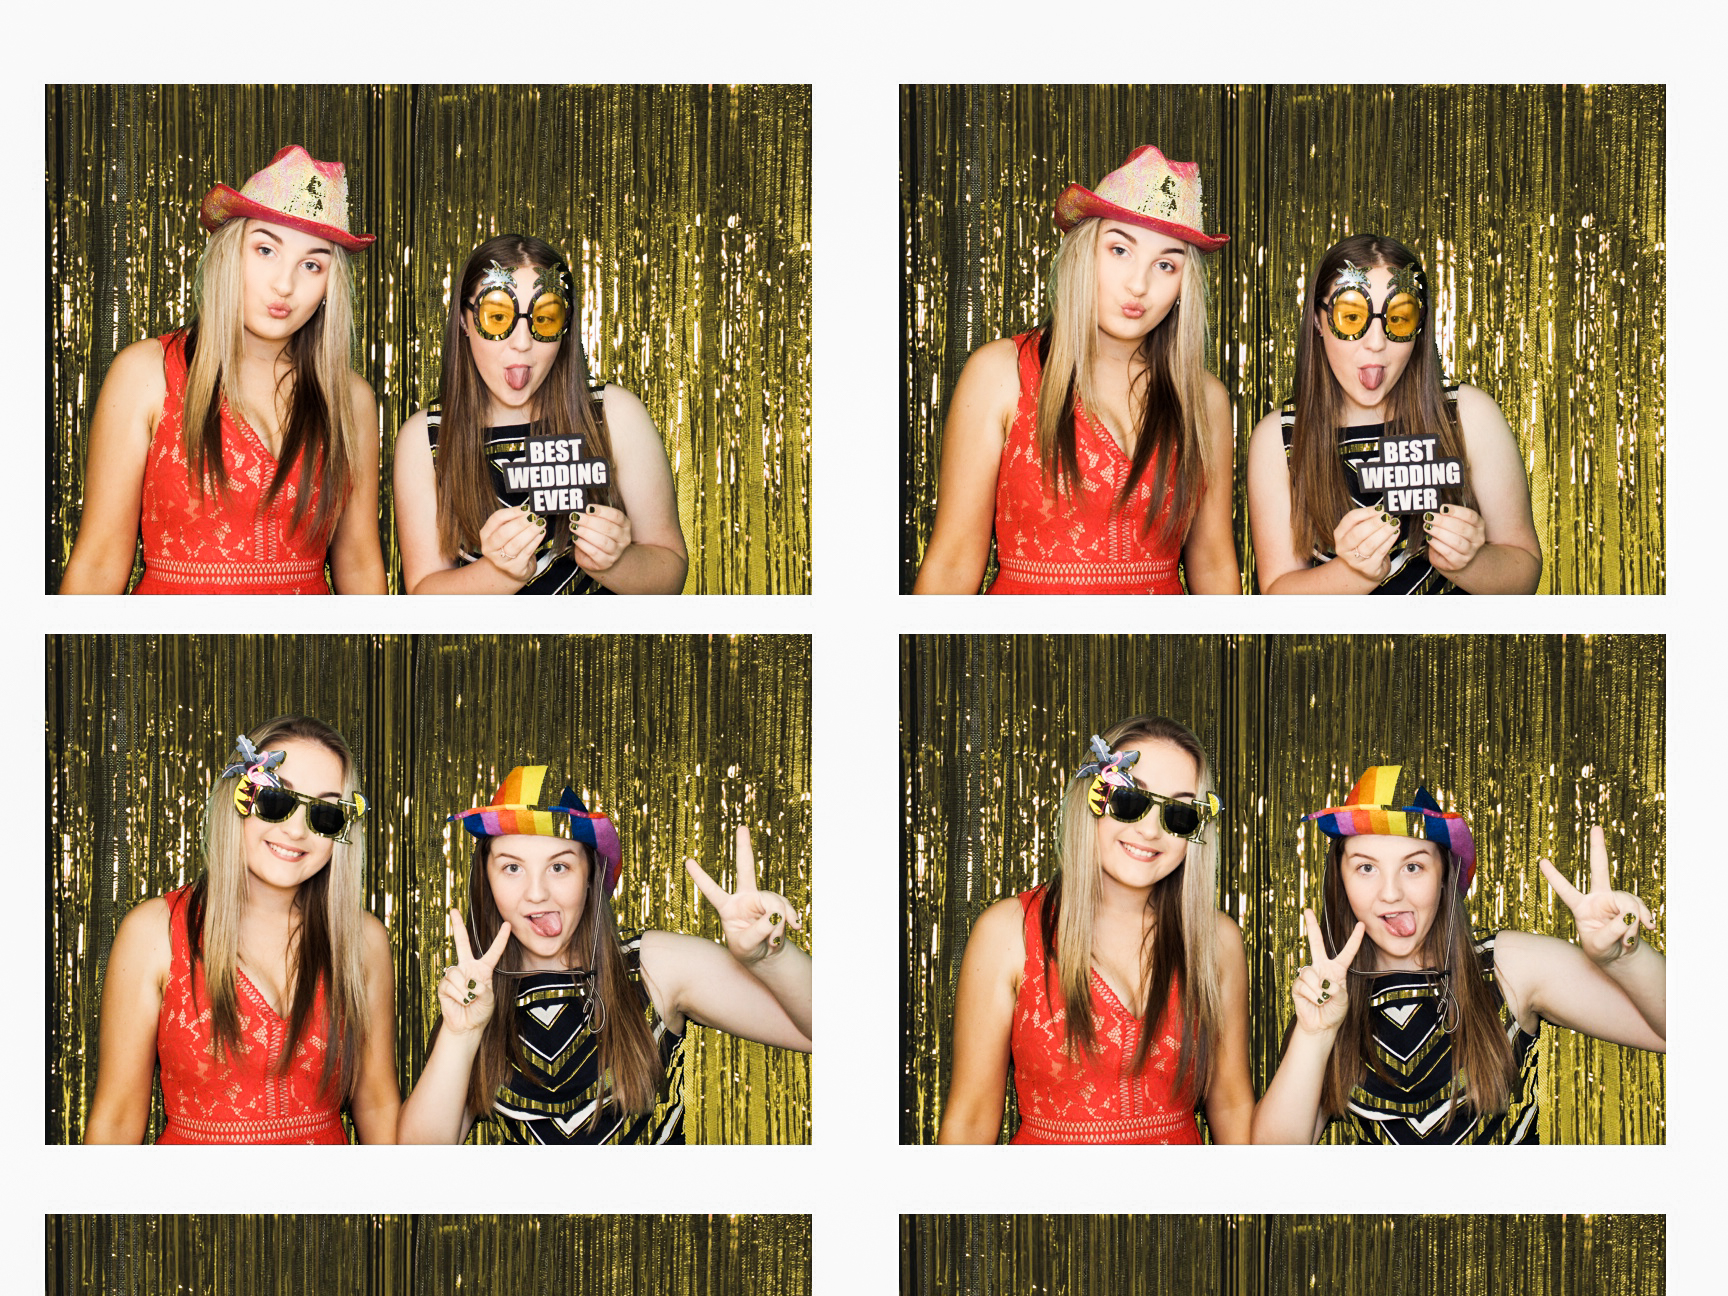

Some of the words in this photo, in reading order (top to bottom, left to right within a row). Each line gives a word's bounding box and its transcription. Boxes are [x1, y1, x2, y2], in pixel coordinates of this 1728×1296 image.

[529, 439, 582, 464] BEST
[1383, 439, 1436, 464] BEST
[507, 461, 607, 490] WEDDING
[1361, 461, 1461, 490] WEDDING
[533, 488, 584, 512] EVER
[1387, 488, 1438, 512] EVER
